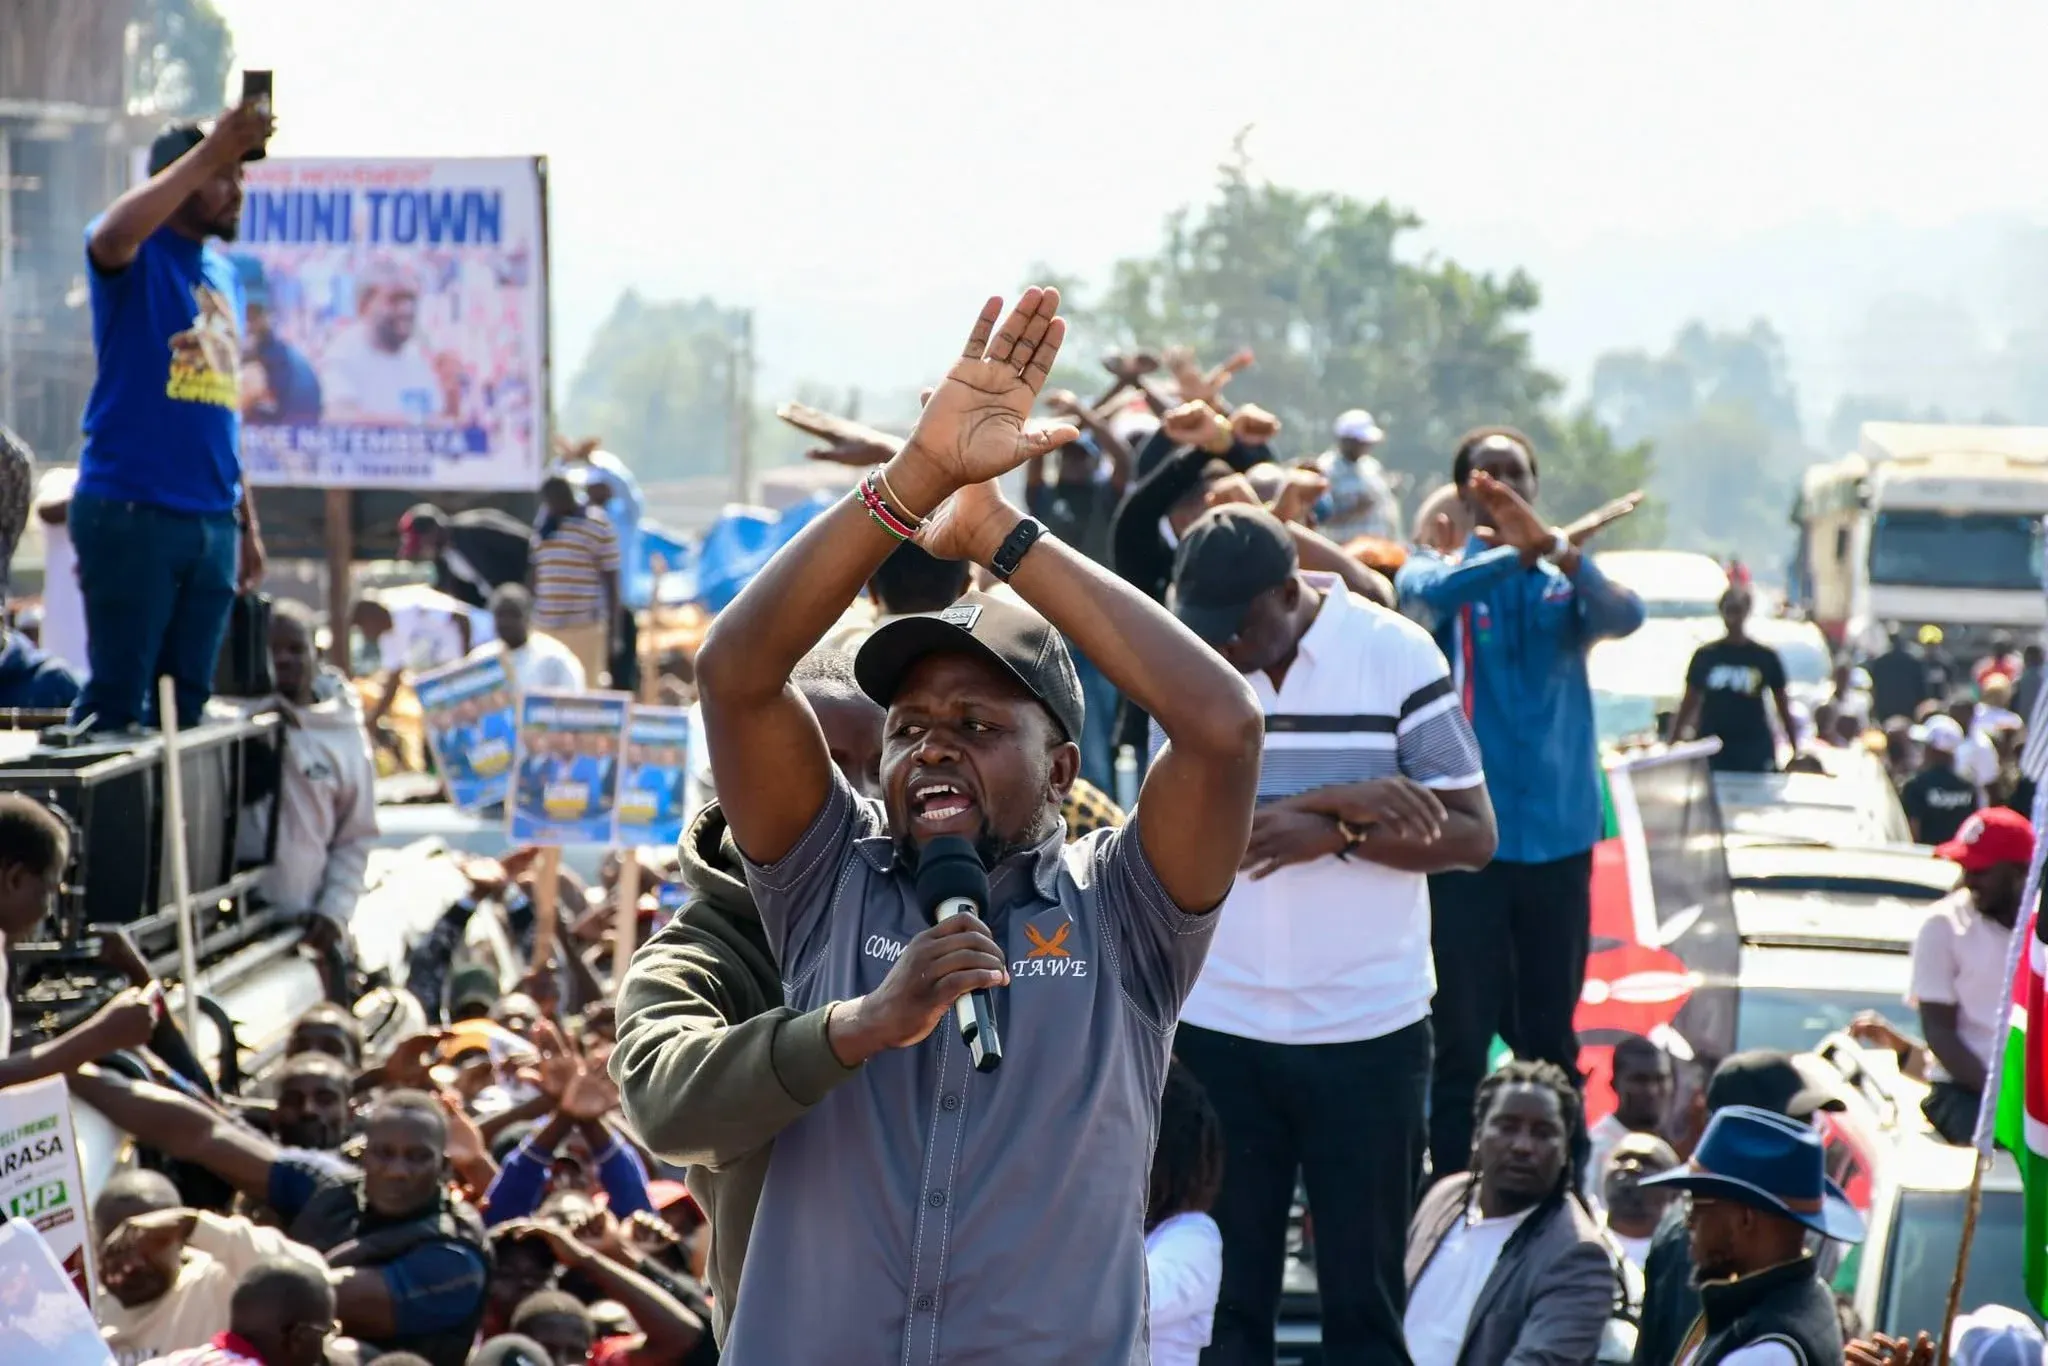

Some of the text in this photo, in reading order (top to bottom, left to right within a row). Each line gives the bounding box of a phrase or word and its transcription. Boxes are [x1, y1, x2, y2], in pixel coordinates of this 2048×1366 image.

[242, 188, 503, 243] ININI TOWN
[865, 935, 907, 962] COMM
[1013, 958, 1087, 977] TAWE
[0, 1136, 63, 1177] RASA
